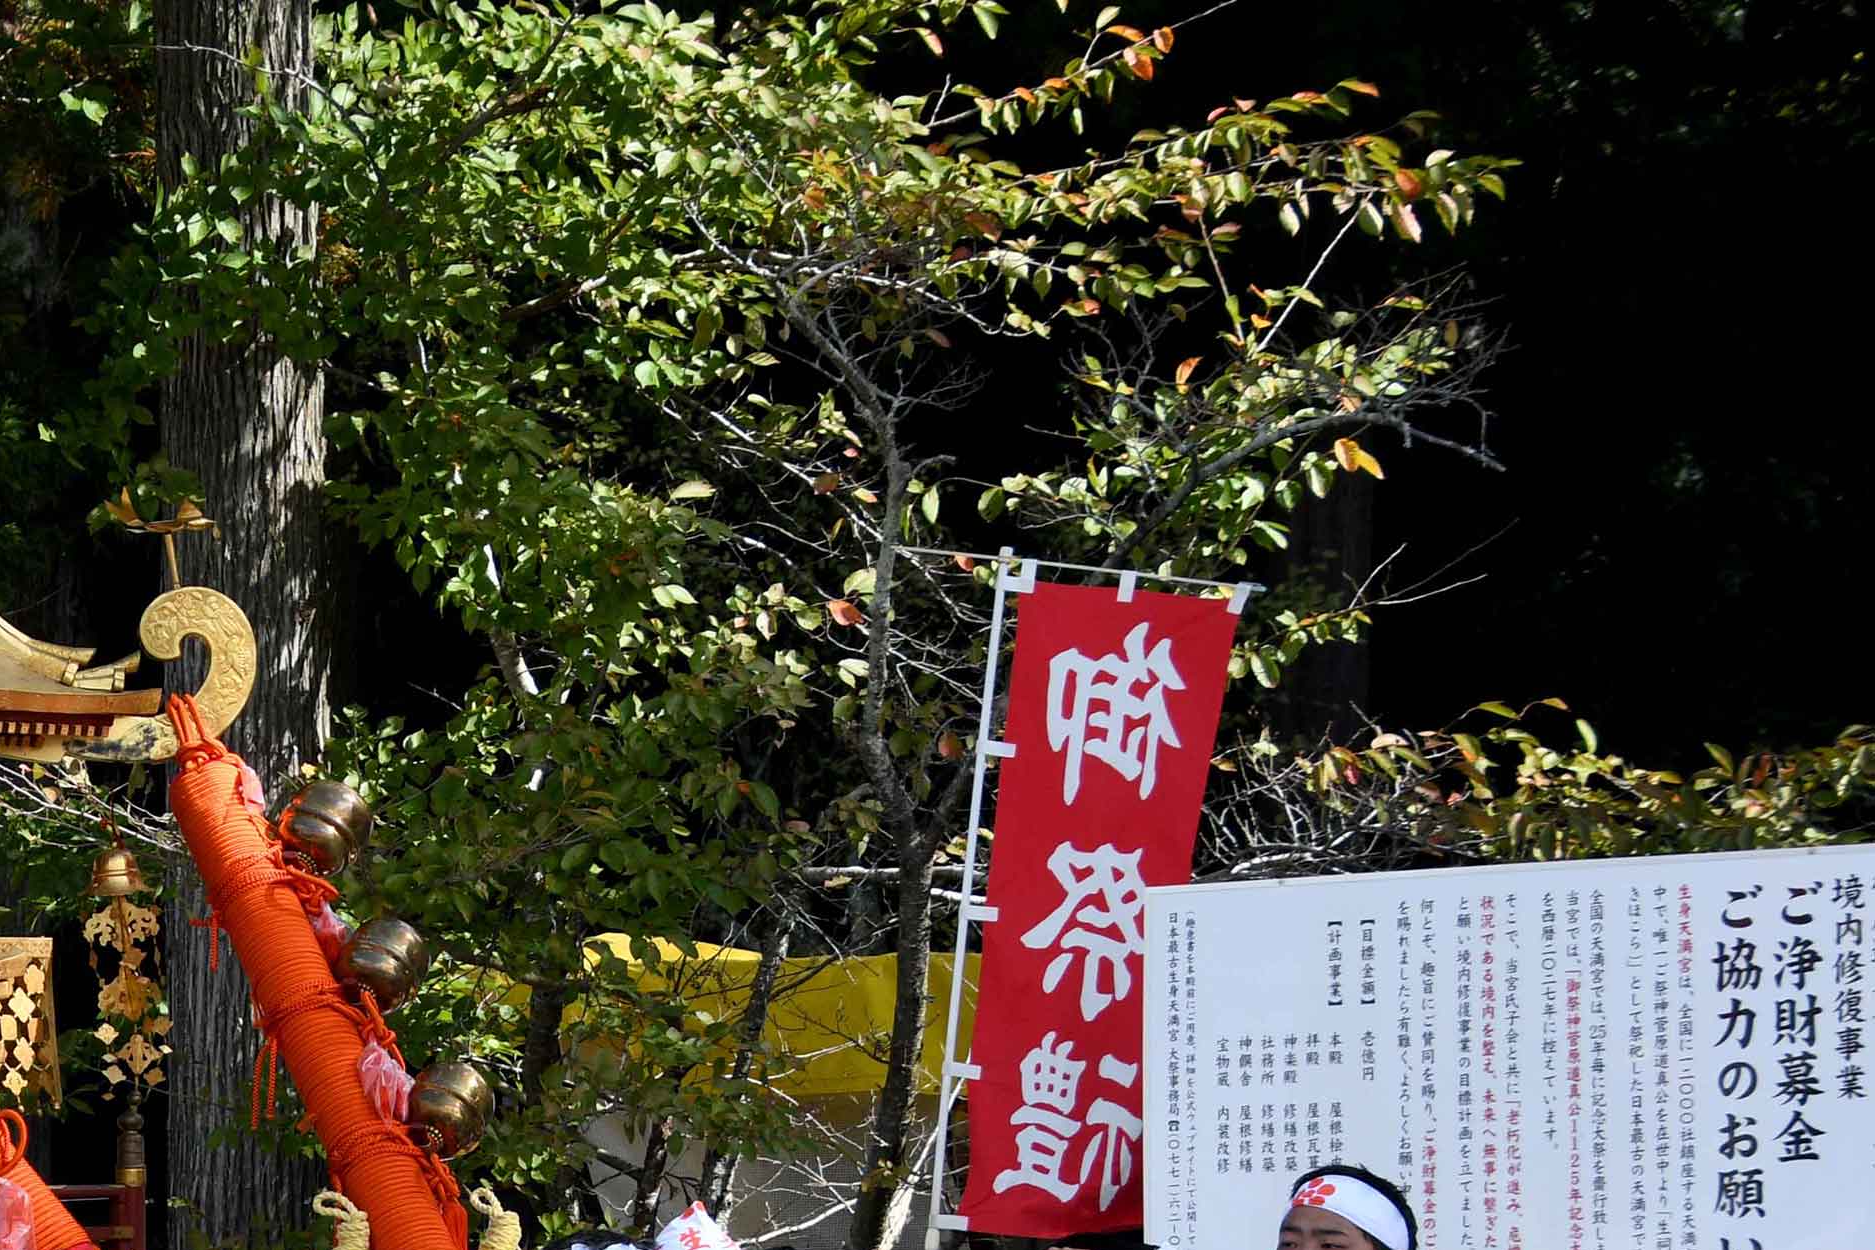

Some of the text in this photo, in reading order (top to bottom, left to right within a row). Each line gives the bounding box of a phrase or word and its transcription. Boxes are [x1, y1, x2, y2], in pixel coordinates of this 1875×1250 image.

[1329, 1032, 1343, 1064] 本殿
[1771, 881, 1827, 1163] ご浄財募金
[1829, 874, 1869, 1100] 境内修復事業
